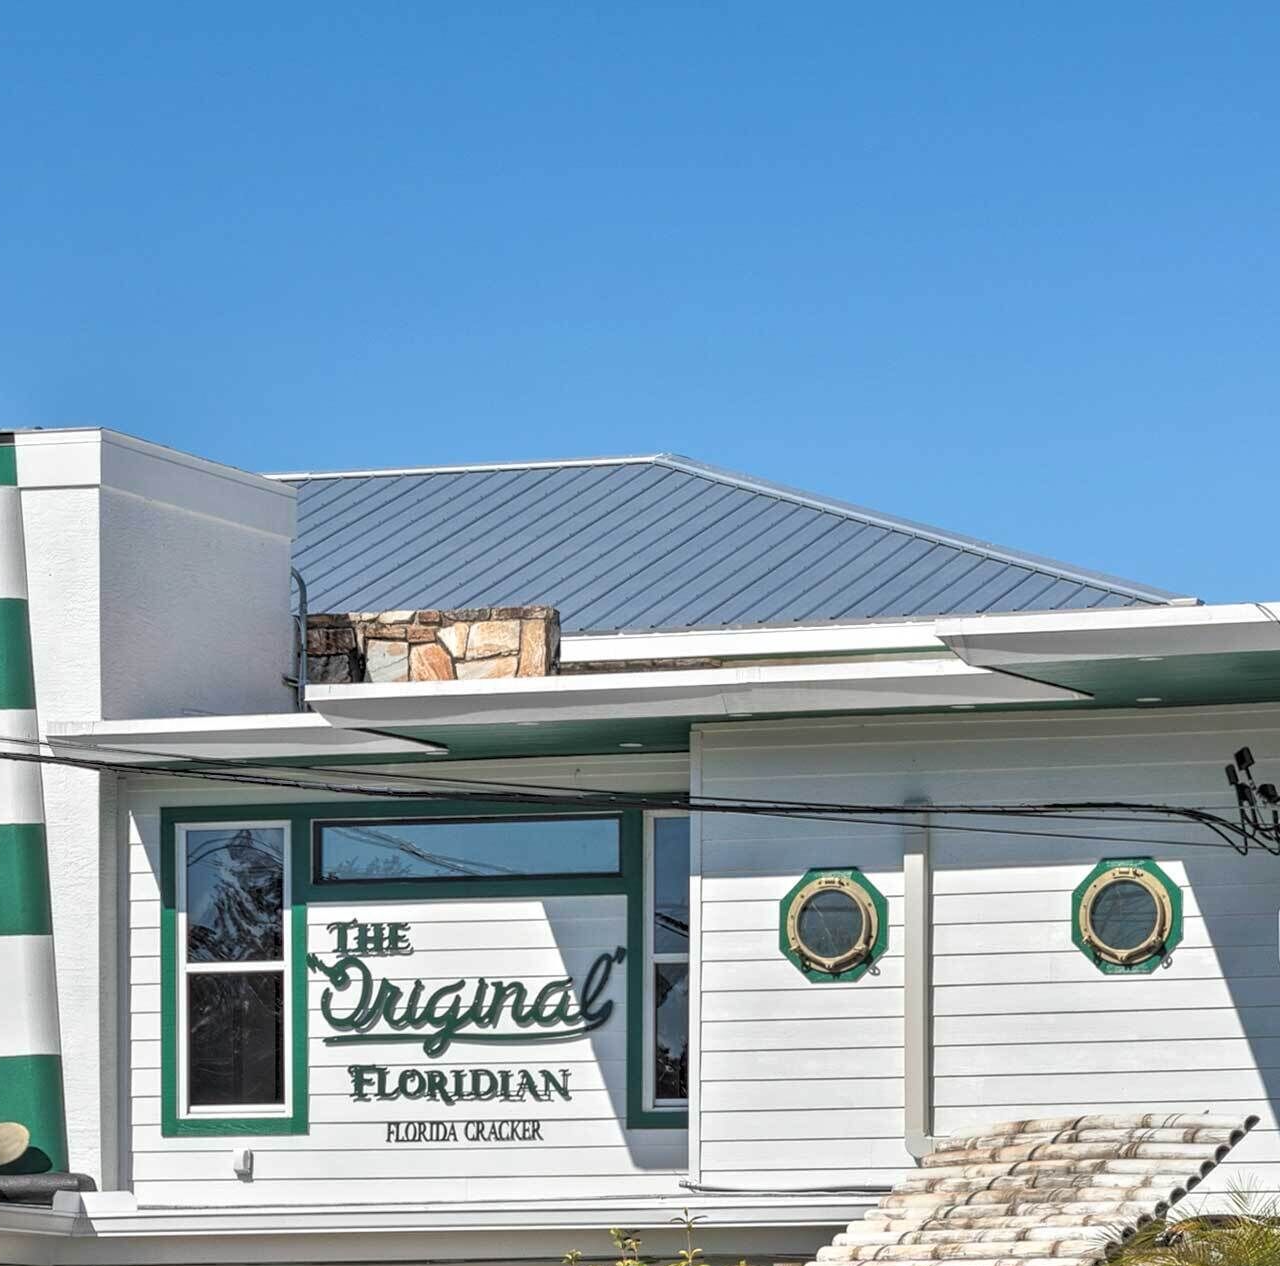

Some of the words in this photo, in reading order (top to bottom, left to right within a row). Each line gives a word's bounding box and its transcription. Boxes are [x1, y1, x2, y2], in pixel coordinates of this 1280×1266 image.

[327, 919, 414, 957] THE
[348, 1064, 572, 1106] FLORIDIAN
[386, 1121, 458, 1143] FLORIDA
[464, 1119, 544, 1142] CRACKER
